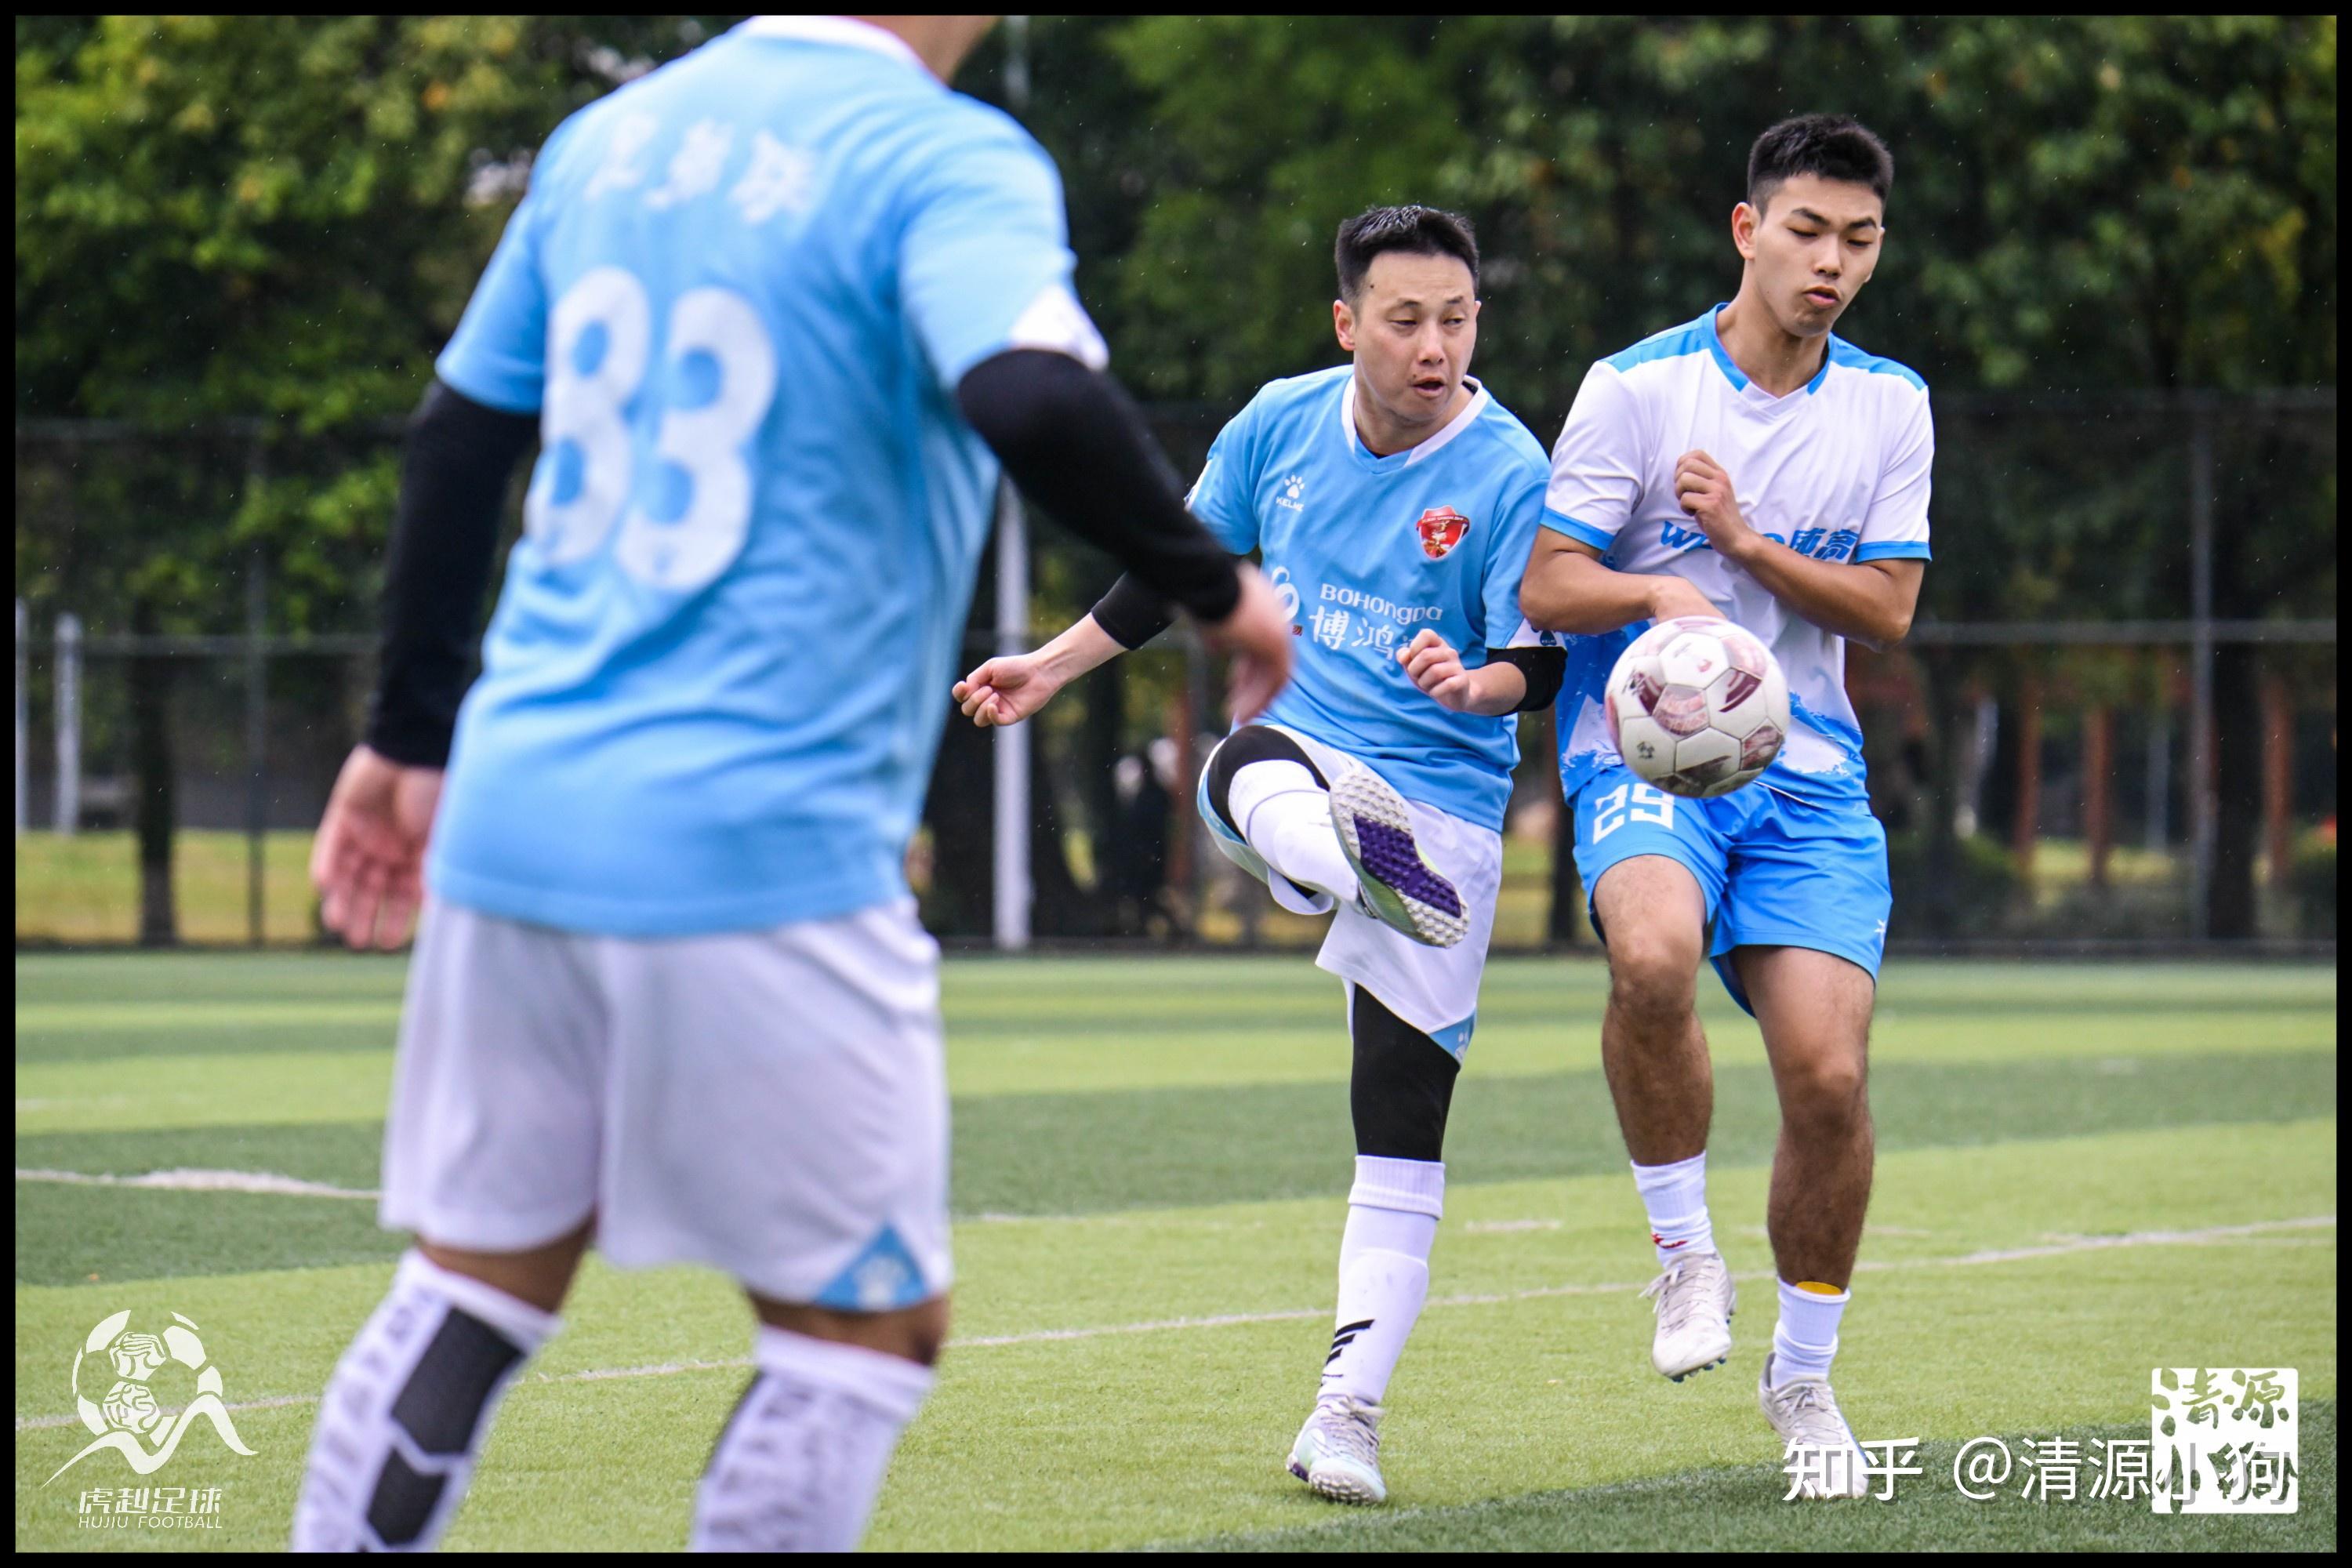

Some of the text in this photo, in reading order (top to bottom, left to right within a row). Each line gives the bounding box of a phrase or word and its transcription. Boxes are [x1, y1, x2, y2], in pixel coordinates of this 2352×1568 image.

[524, 267, 777, 596] 83
[1308, 604, 1412, 660] 博鸿
[1592, 782, 1675, 845] 29
